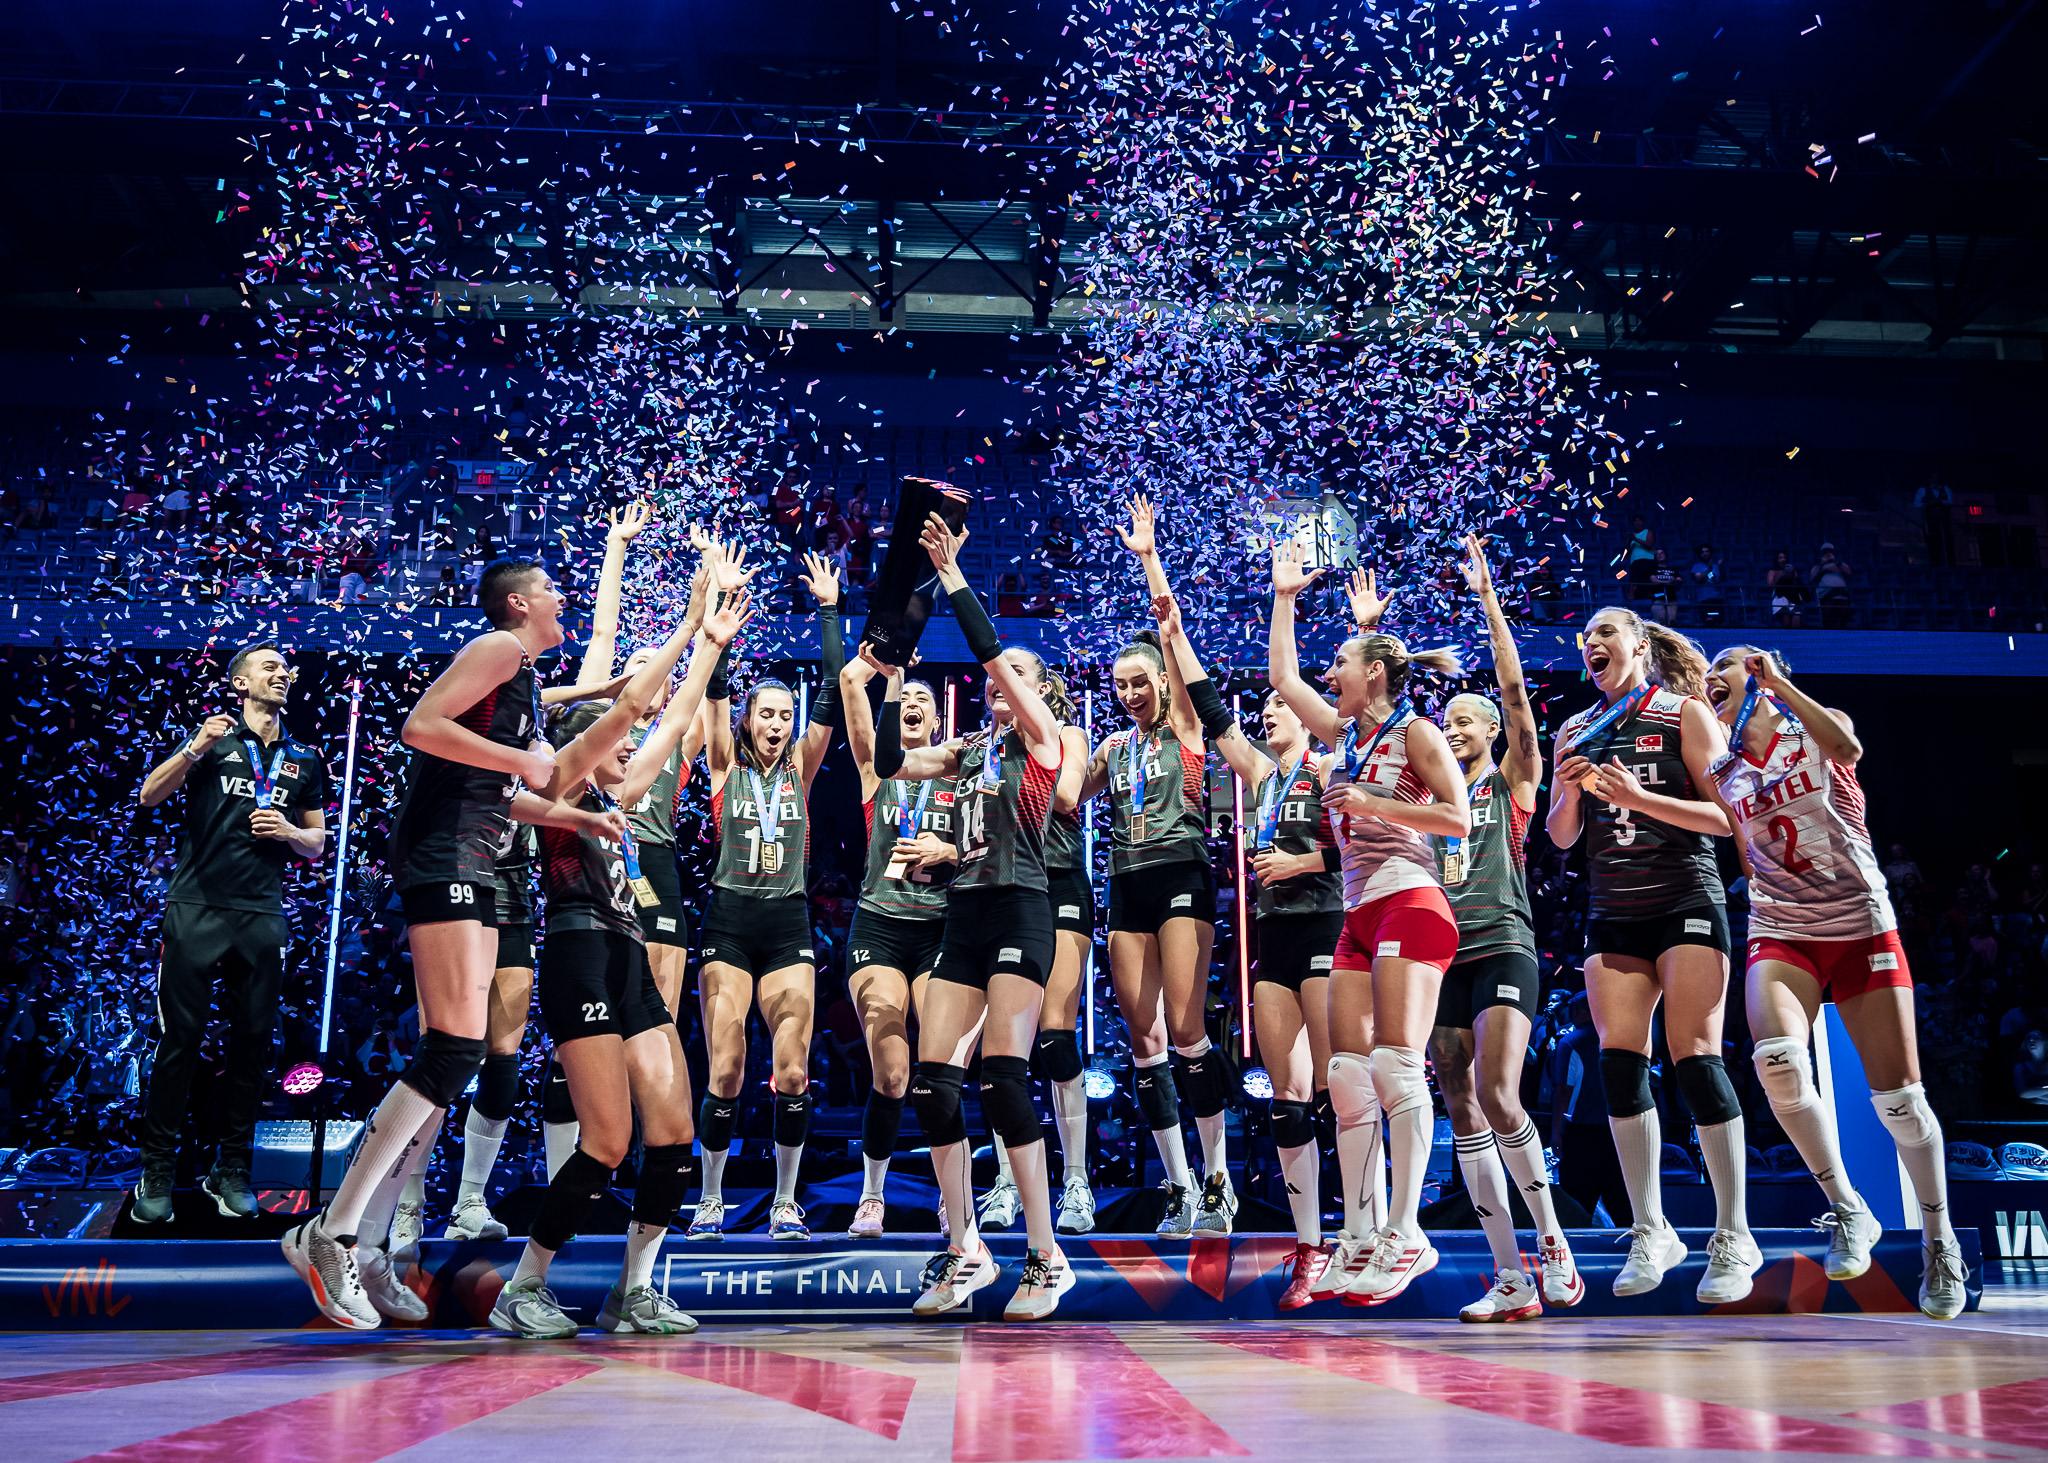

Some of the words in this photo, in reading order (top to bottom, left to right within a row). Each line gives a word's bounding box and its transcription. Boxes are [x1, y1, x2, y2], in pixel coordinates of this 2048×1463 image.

[220, 775, 289, 808] VESEL
[1110, 759, 1169, 795] VEEL
[732, 799, 803, 821] VEEL
[1733, 771, 1824, 825] VESTEL
[1608, 802, 1637, 847] 3
[1767, 814, 1815, 874] 2
[449, 883, 475, 904] 99
[609, 858, 637, 915] 2
[852, 949, 871, 964] 12
[1749, 942, 1761, 958] 2
[581, 1001, 610, 1023] 22
[42, 1256, 133, 1318] VNL
[701, 1270, 775, 1295] THE
